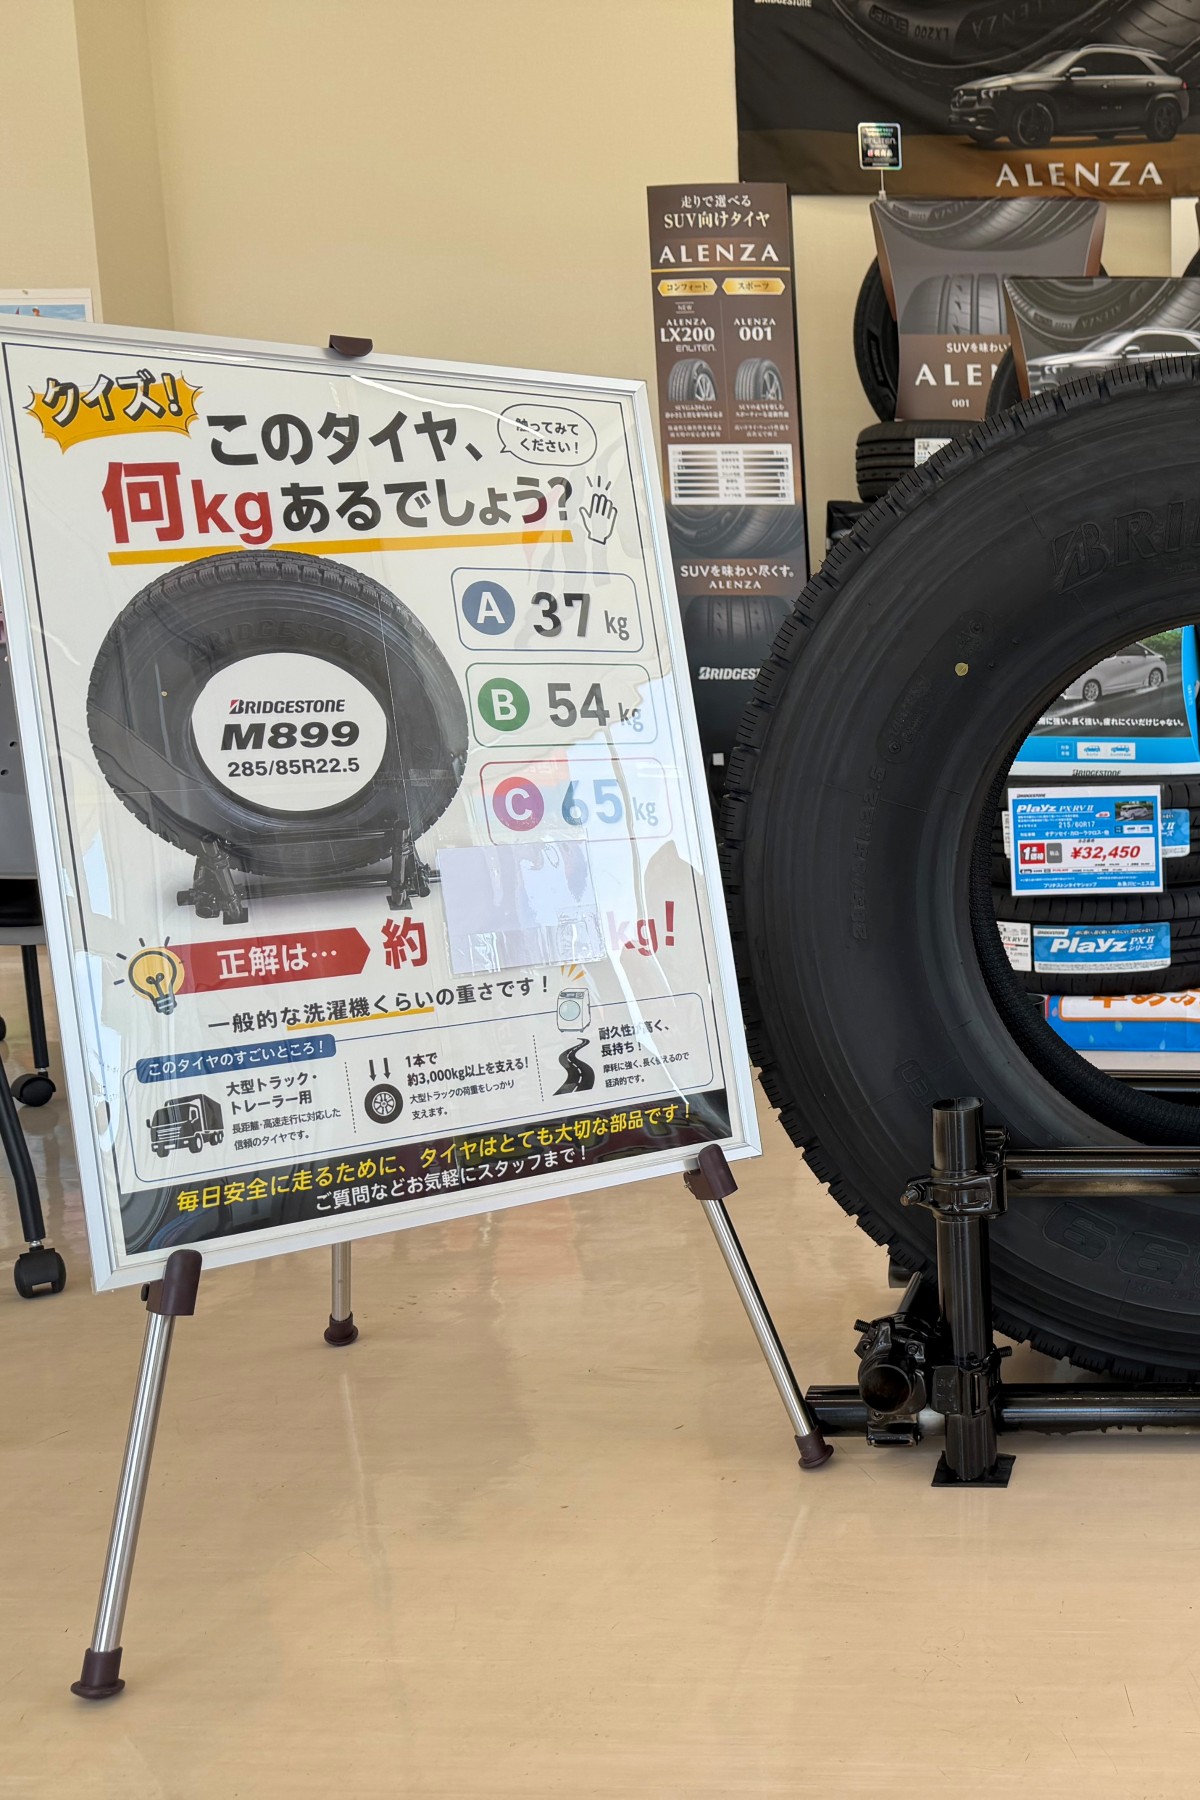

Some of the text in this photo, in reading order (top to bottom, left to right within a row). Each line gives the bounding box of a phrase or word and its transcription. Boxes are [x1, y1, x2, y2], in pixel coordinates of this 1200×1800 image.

[914, 26, 950, 41] LX200
[995, 161, 1164, 187] ALENZA
[681, 194, 752, 209] 走りで選べる
[663, 211, 770, 229] SUV向けタイヤ
[659, 244, 779, 264] ALENZA
[666, 282, 708, 292] コンフォート
[737, 281, 769, 290] スポーツ
[666, 318, 707, 326] ALENZA
[733, 317, 776, 326] ALENZA
[660, 327, 716, 342] LX200
[739, 327, 773, 341] 001
[952, 399, 970, 408] 001
[207, 411, 483, 466] このタイヤ、
[680, 564, 794, 578] SUVを味わい尽くす。
[709, 580, 761, 589] ALENZA
[477, 591, 630, 641] A 37 kg
[229, 699, 345, 715] BRIDGESTONE
[491, 683, 644, 732] B 54 kg
[221, 720, 360, 751] M899
[227, 758, 360, 778] 285/85R22.5
[505, 779, 659, 827] C 65 kg
[1017, 804, 1056, 813] Playz
[1070, 845, 1141, 861] ¥32,450
[382, 916, 428, 970] 約
[611, 901, 676, 957] kg!
[1050, 937, 1128, 954] Playz
[1128, 944, 1153, 952] シリーズ
[405, 1052, 438, 1068] 1本で
[605, 1075, 645, 1089] 経済的です。
[409, 1080, 515, 1105] 大型トラックの荷重をしっかり
[231, 1090, 313, 1115] トレーラー用
[232, 1108, 342, 1134] 長距離・高速走行に対応した
[411, 1107, 448, 1121] 支えます。
[234, 1130, 310, 1151] 信頼のタイヤです。
